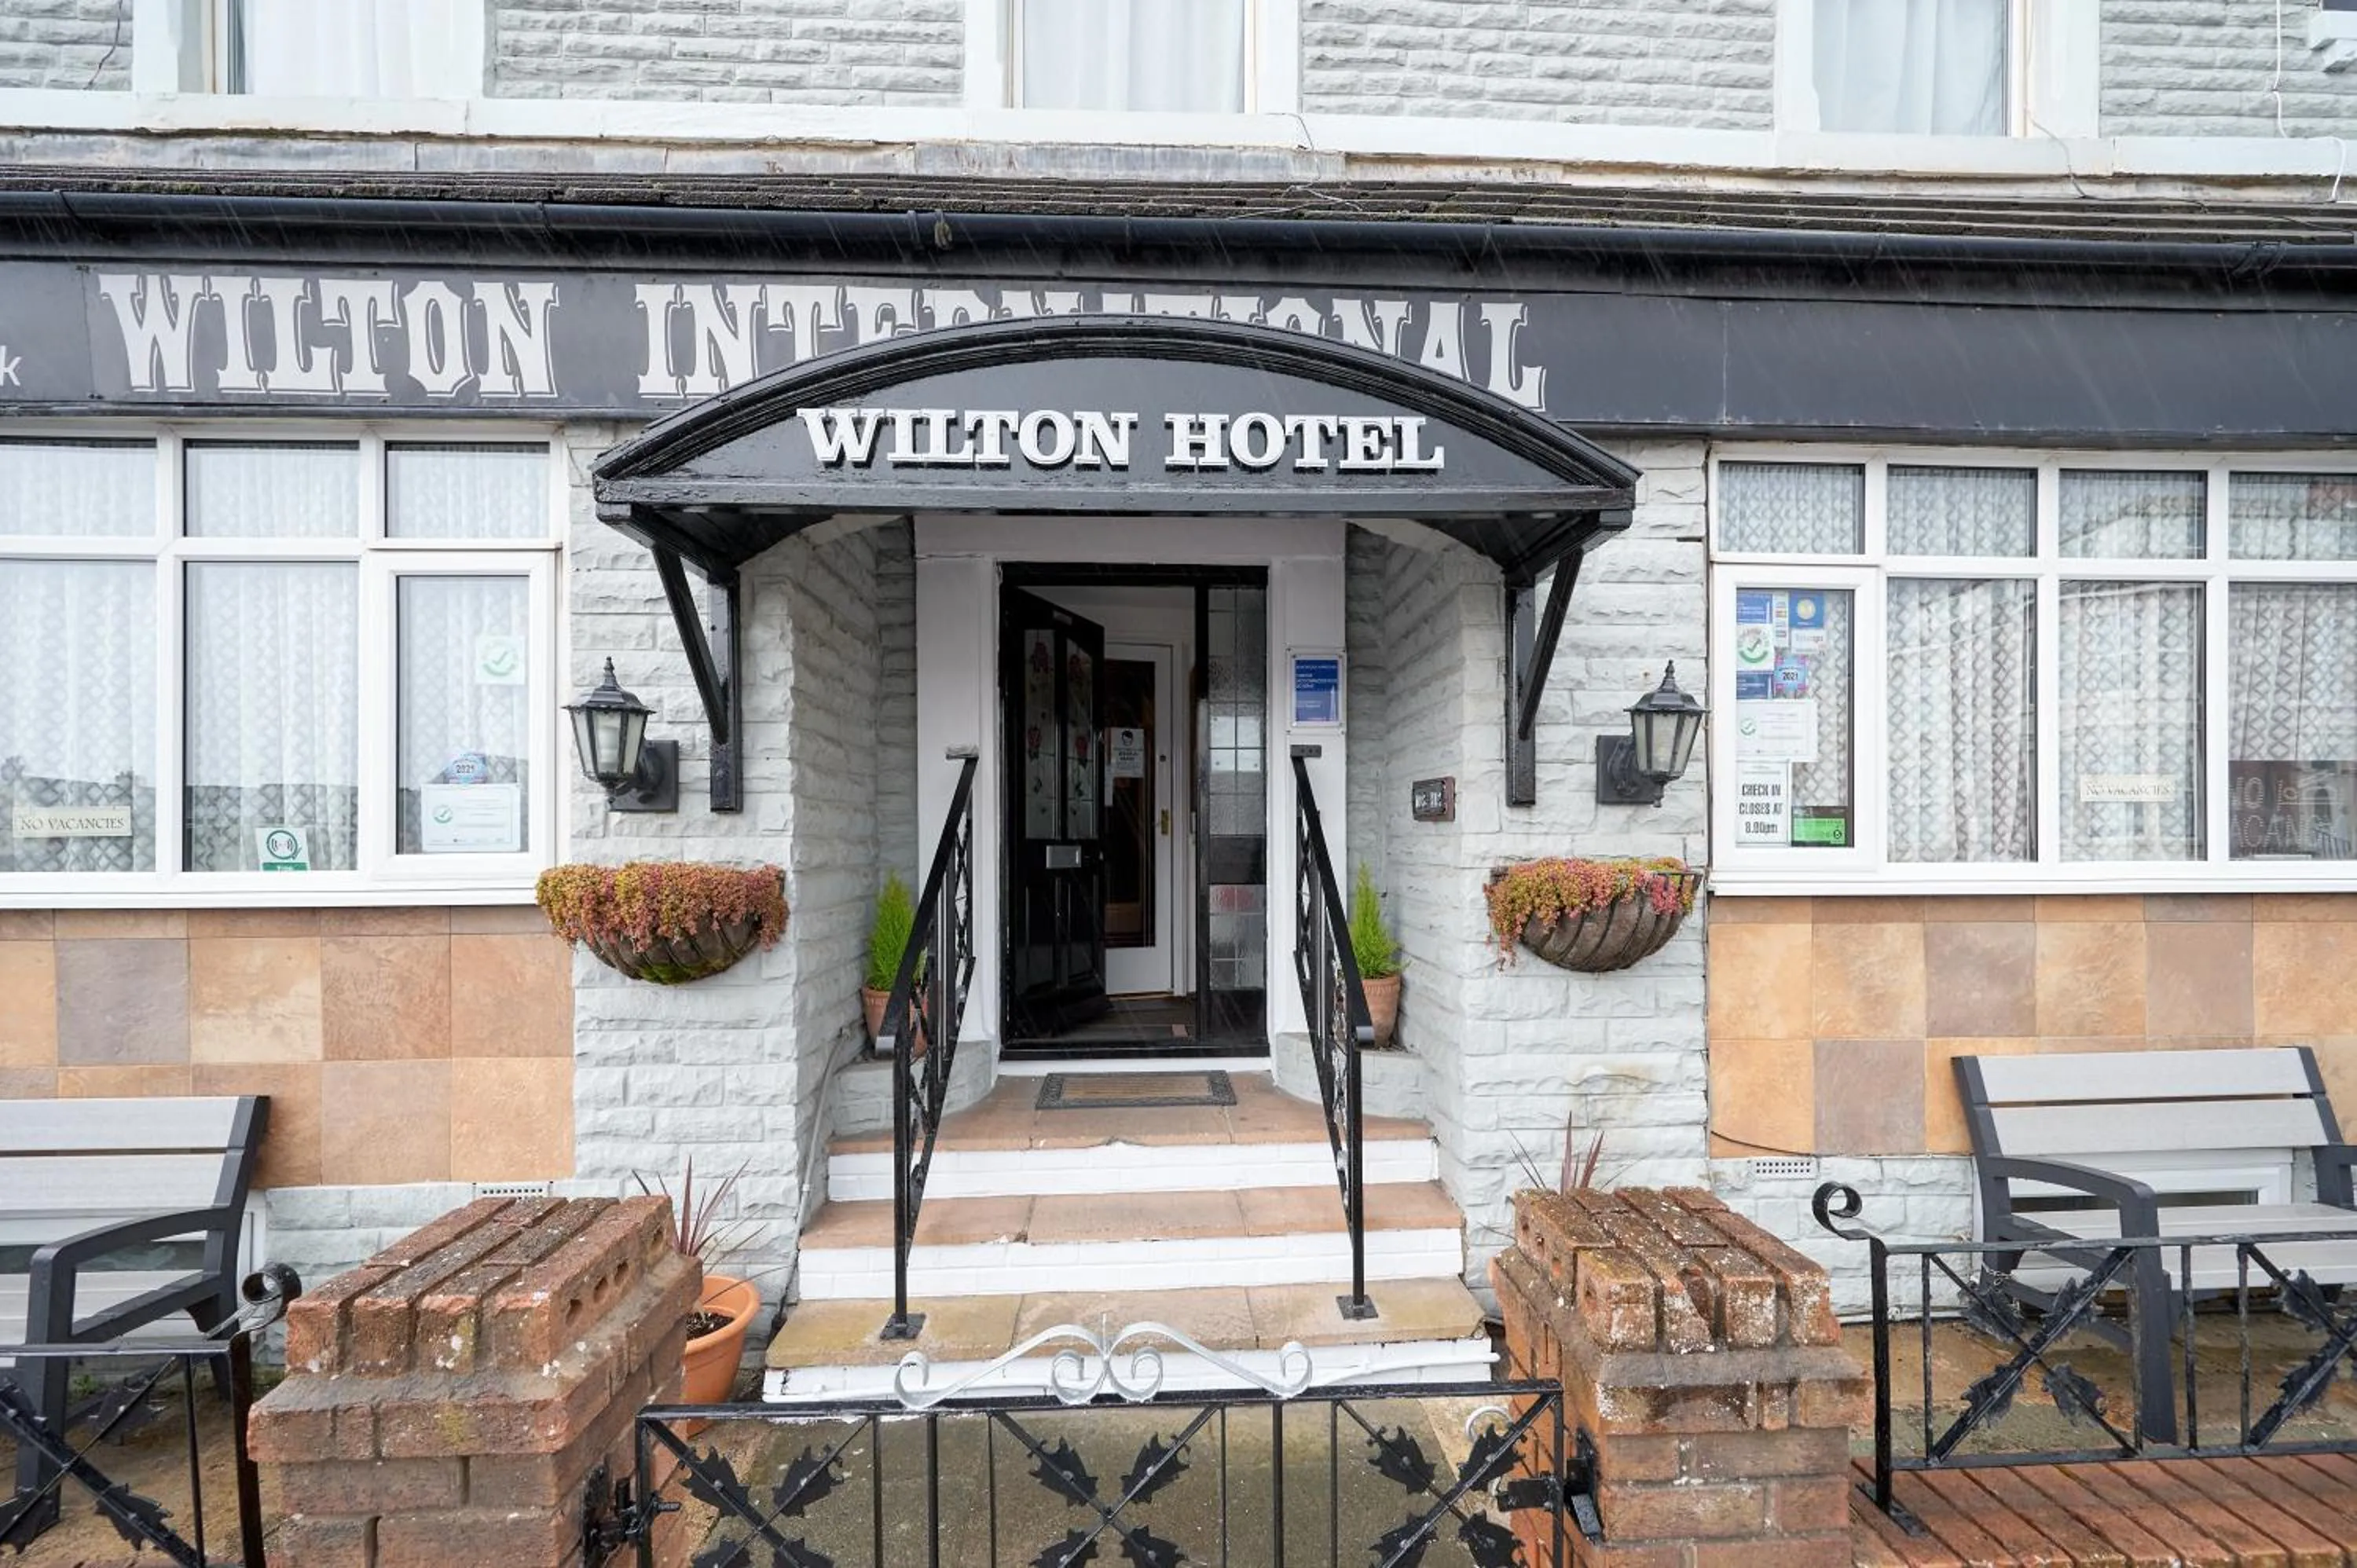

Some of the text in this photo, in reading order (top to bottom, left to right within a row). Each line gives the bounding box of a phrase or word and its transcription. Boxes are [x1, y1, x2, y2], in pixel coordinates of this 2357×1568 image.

[98, 273, 560, 398] WILTON
[797, 408, 1446, 470] WILTON HOTEL
[1742, 783, 1781, 797] CHECK IN
[1738, 802, 1783, 815] CLOSES AT
[20, 815, 126, 831] NO VACANCIES
